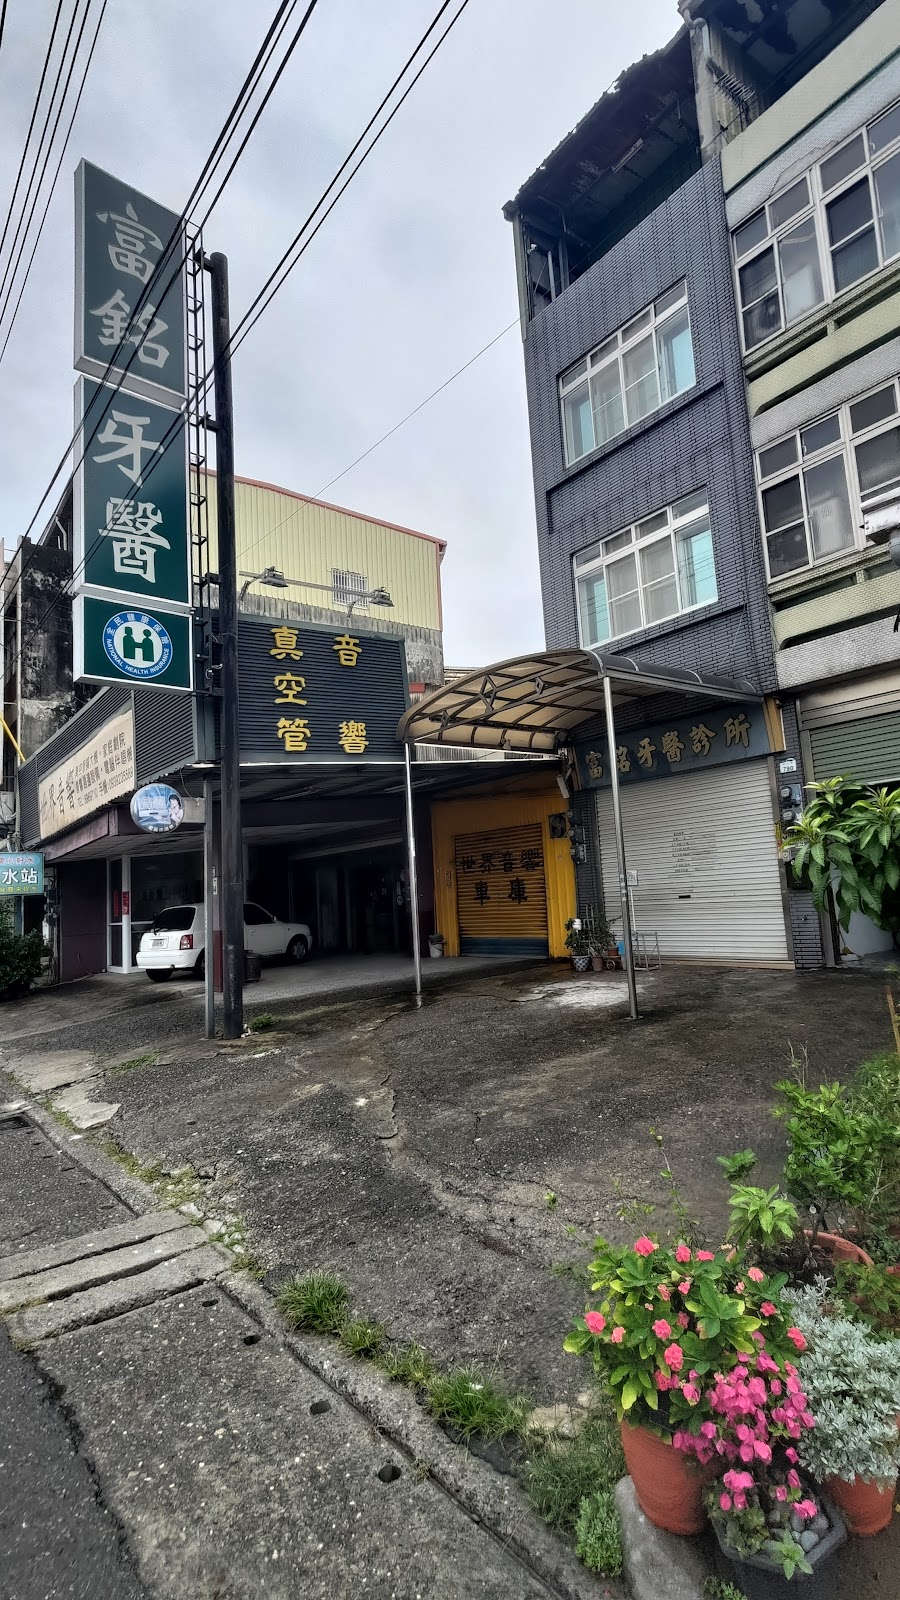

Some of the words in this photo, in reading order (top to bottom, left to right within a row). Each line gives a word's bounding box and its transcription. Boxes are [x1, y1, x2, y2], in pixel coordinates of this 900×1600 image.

[106, 638, 124, 667] NATIONAL
[125, 664, 149, 675] HEALTH
[149, 647, 170, 674] INSURANCE
[459, 849, 542, 874] 世界音響
[1, 868, 38, 885] 水站
[474, 877, 529, 906] 車庫
